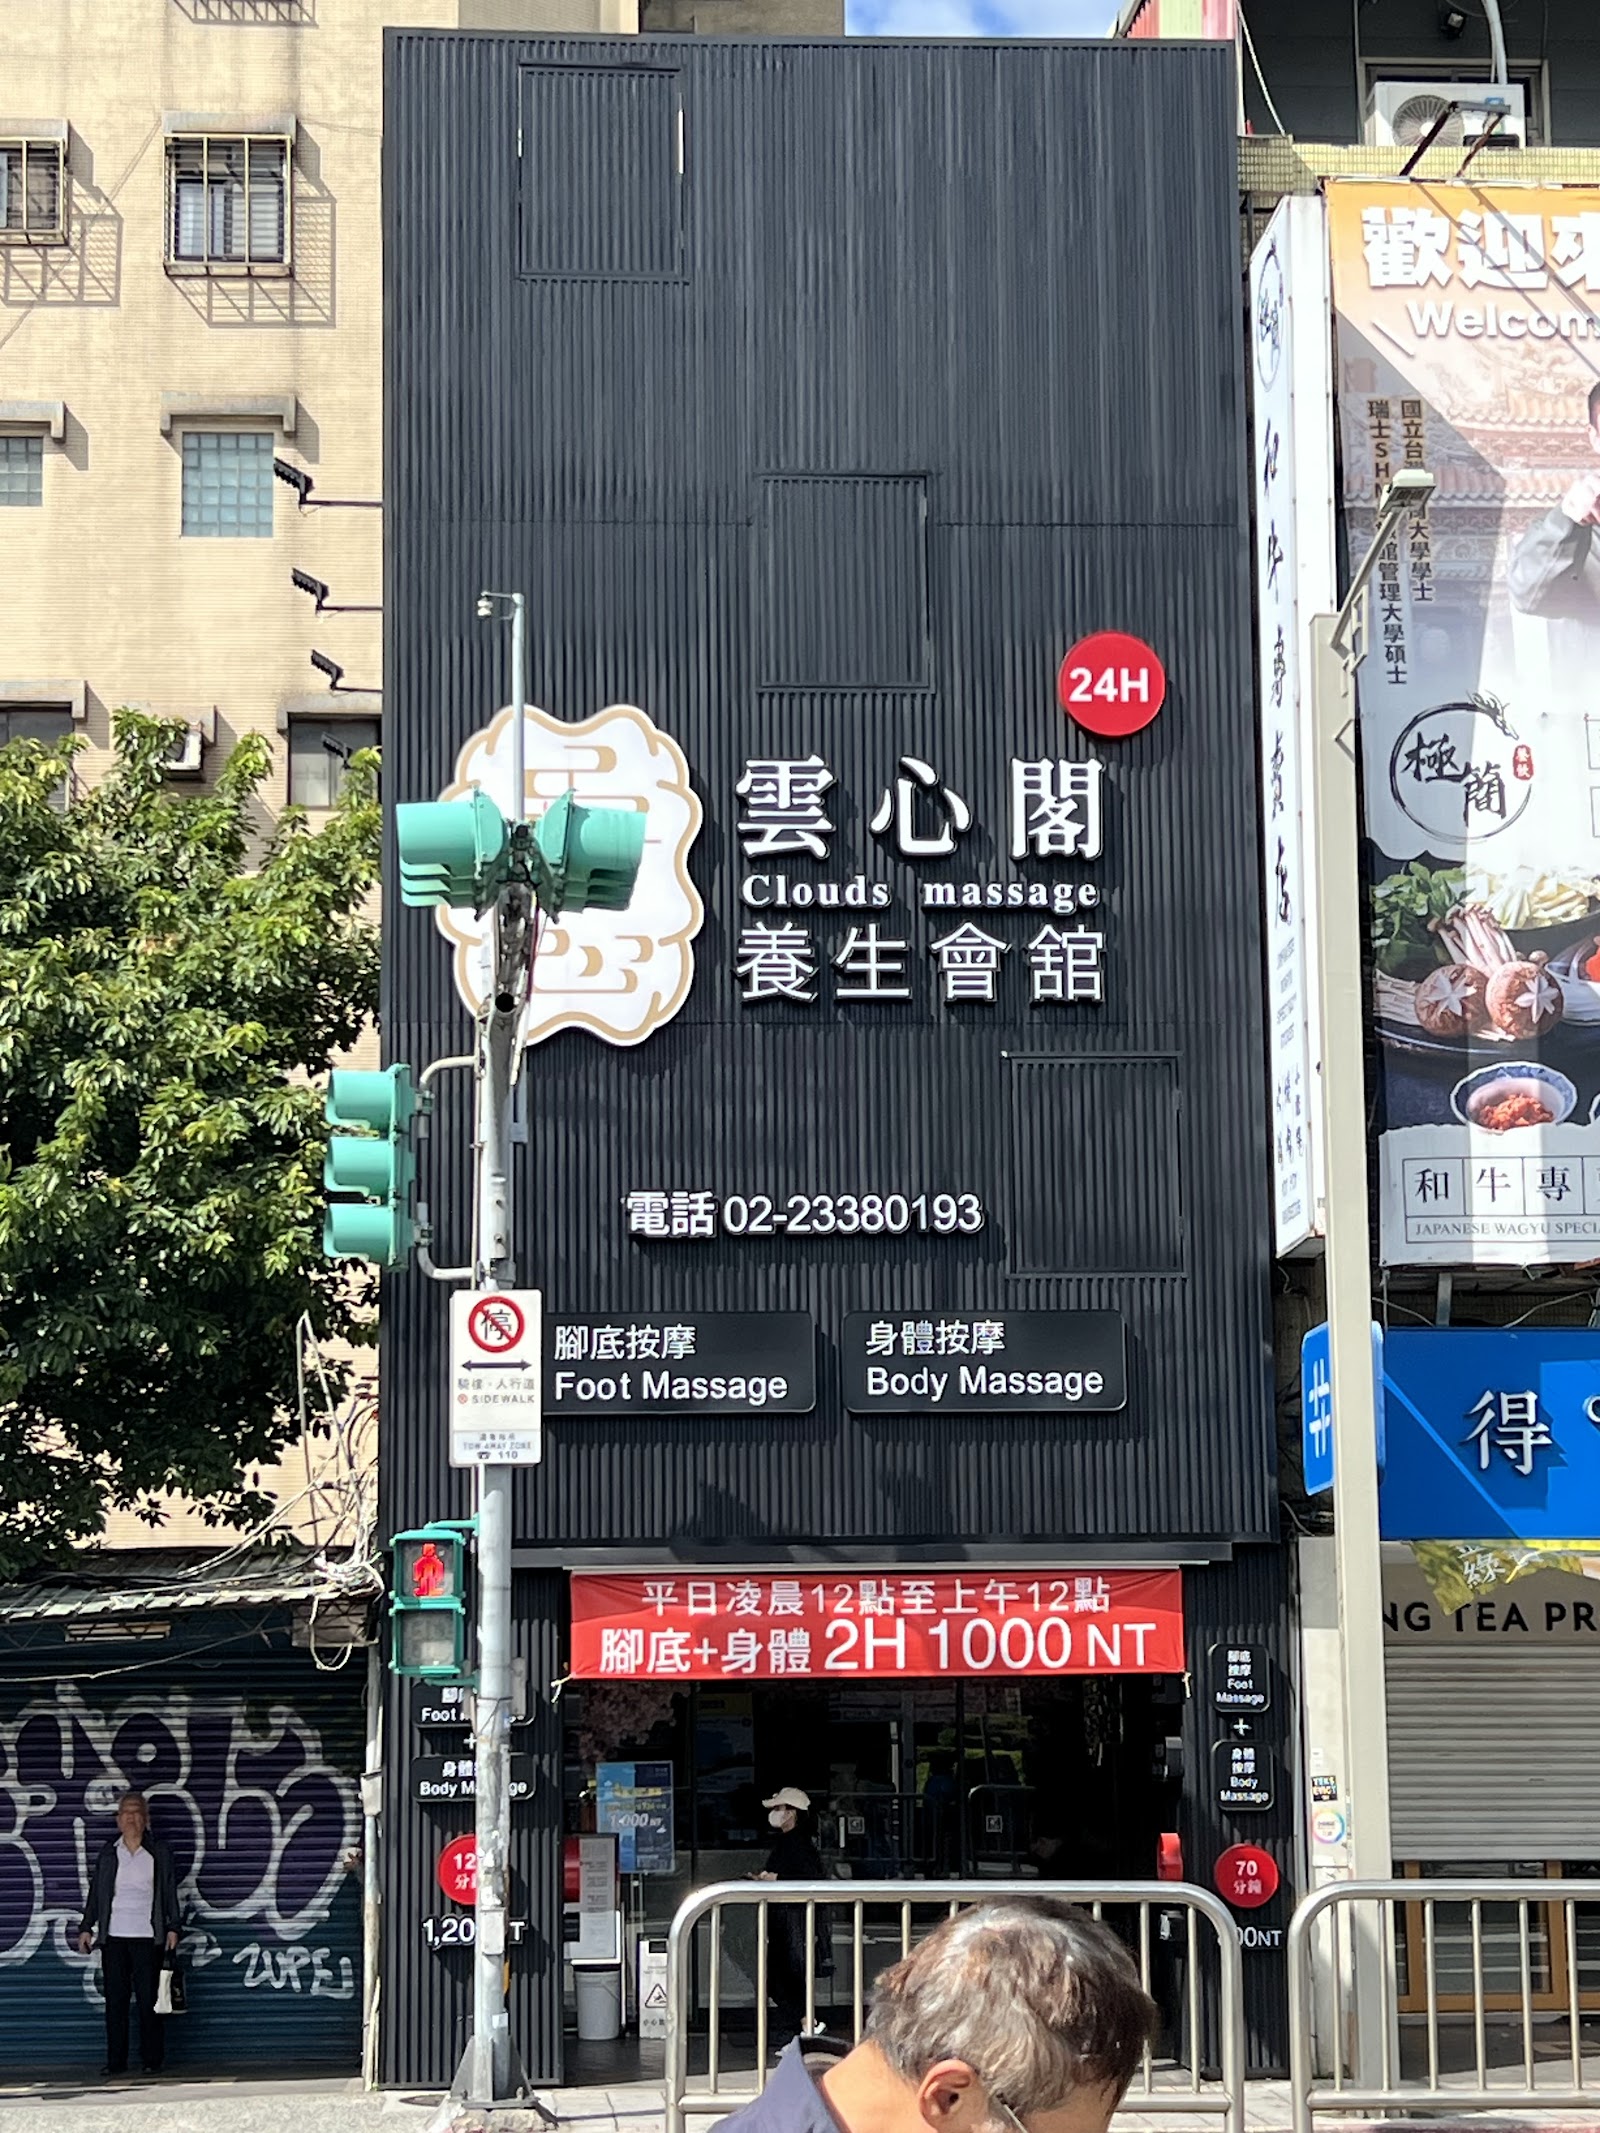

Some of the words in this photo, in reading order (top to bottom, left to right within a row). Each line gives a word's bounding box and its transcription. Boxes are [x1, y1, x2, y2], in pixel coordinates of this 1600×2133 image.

[1069, 667, 1150, 702] 24H
[736, 755, 1104, 859] 雲心閣
[742, 875, 891, 906] Clouds
[923, 879, 1100, 913] massage
[1415, 1166, 1600, 1203] 和牛專
[626, 1191, 716, 1239] 電話
[722, 1192, 984, 1234] 02-23380193
[1416, 1222, 1491, 1236] JAPANESE
[1495, 1222, 1550, 1235] WAGYU
[554, 1323, 697, 1361] 腳底按摩
[865, 1320, 1005, 1356] 身體按摩
[472, 1394, 535, 1404] SIDEWALK
[554, 1371, 633, 1401] Foot
[641, 1371, 788, 1405] Massage
[866, 1366, 948, 1402] Body
[958, 1364, 1104, 1400] Massage
[1464, 1389, 1553, 1476] 得
[641, 1576, 1112, 1618] 平日凌晨12點至上午12點
[1455, 1602, 1529, 1632] TEA
[1545, 1602, 1597, 1631] PR
[600, 1627, 812, 1676] 腳底+身體
[824, 1618, 906, 1672] 2H
[929, 1615, 1073, 1672] 1000
[1086, 1622, 1157, 1668] NT
[1216, 1692, 1265, 1706] Massage
[1227, 1678, 1254, 1690] Foot
[421, 1707, 457, 1722] Foot
[420, 1781, 458, 1798] Body
[1220, 1790, 1270, 1804] Massage
[1230, 1776, 1259, 1790] Body
[453, 1853, 477, 1870] 12
[1235, 1860, 1258, 1877] 70
